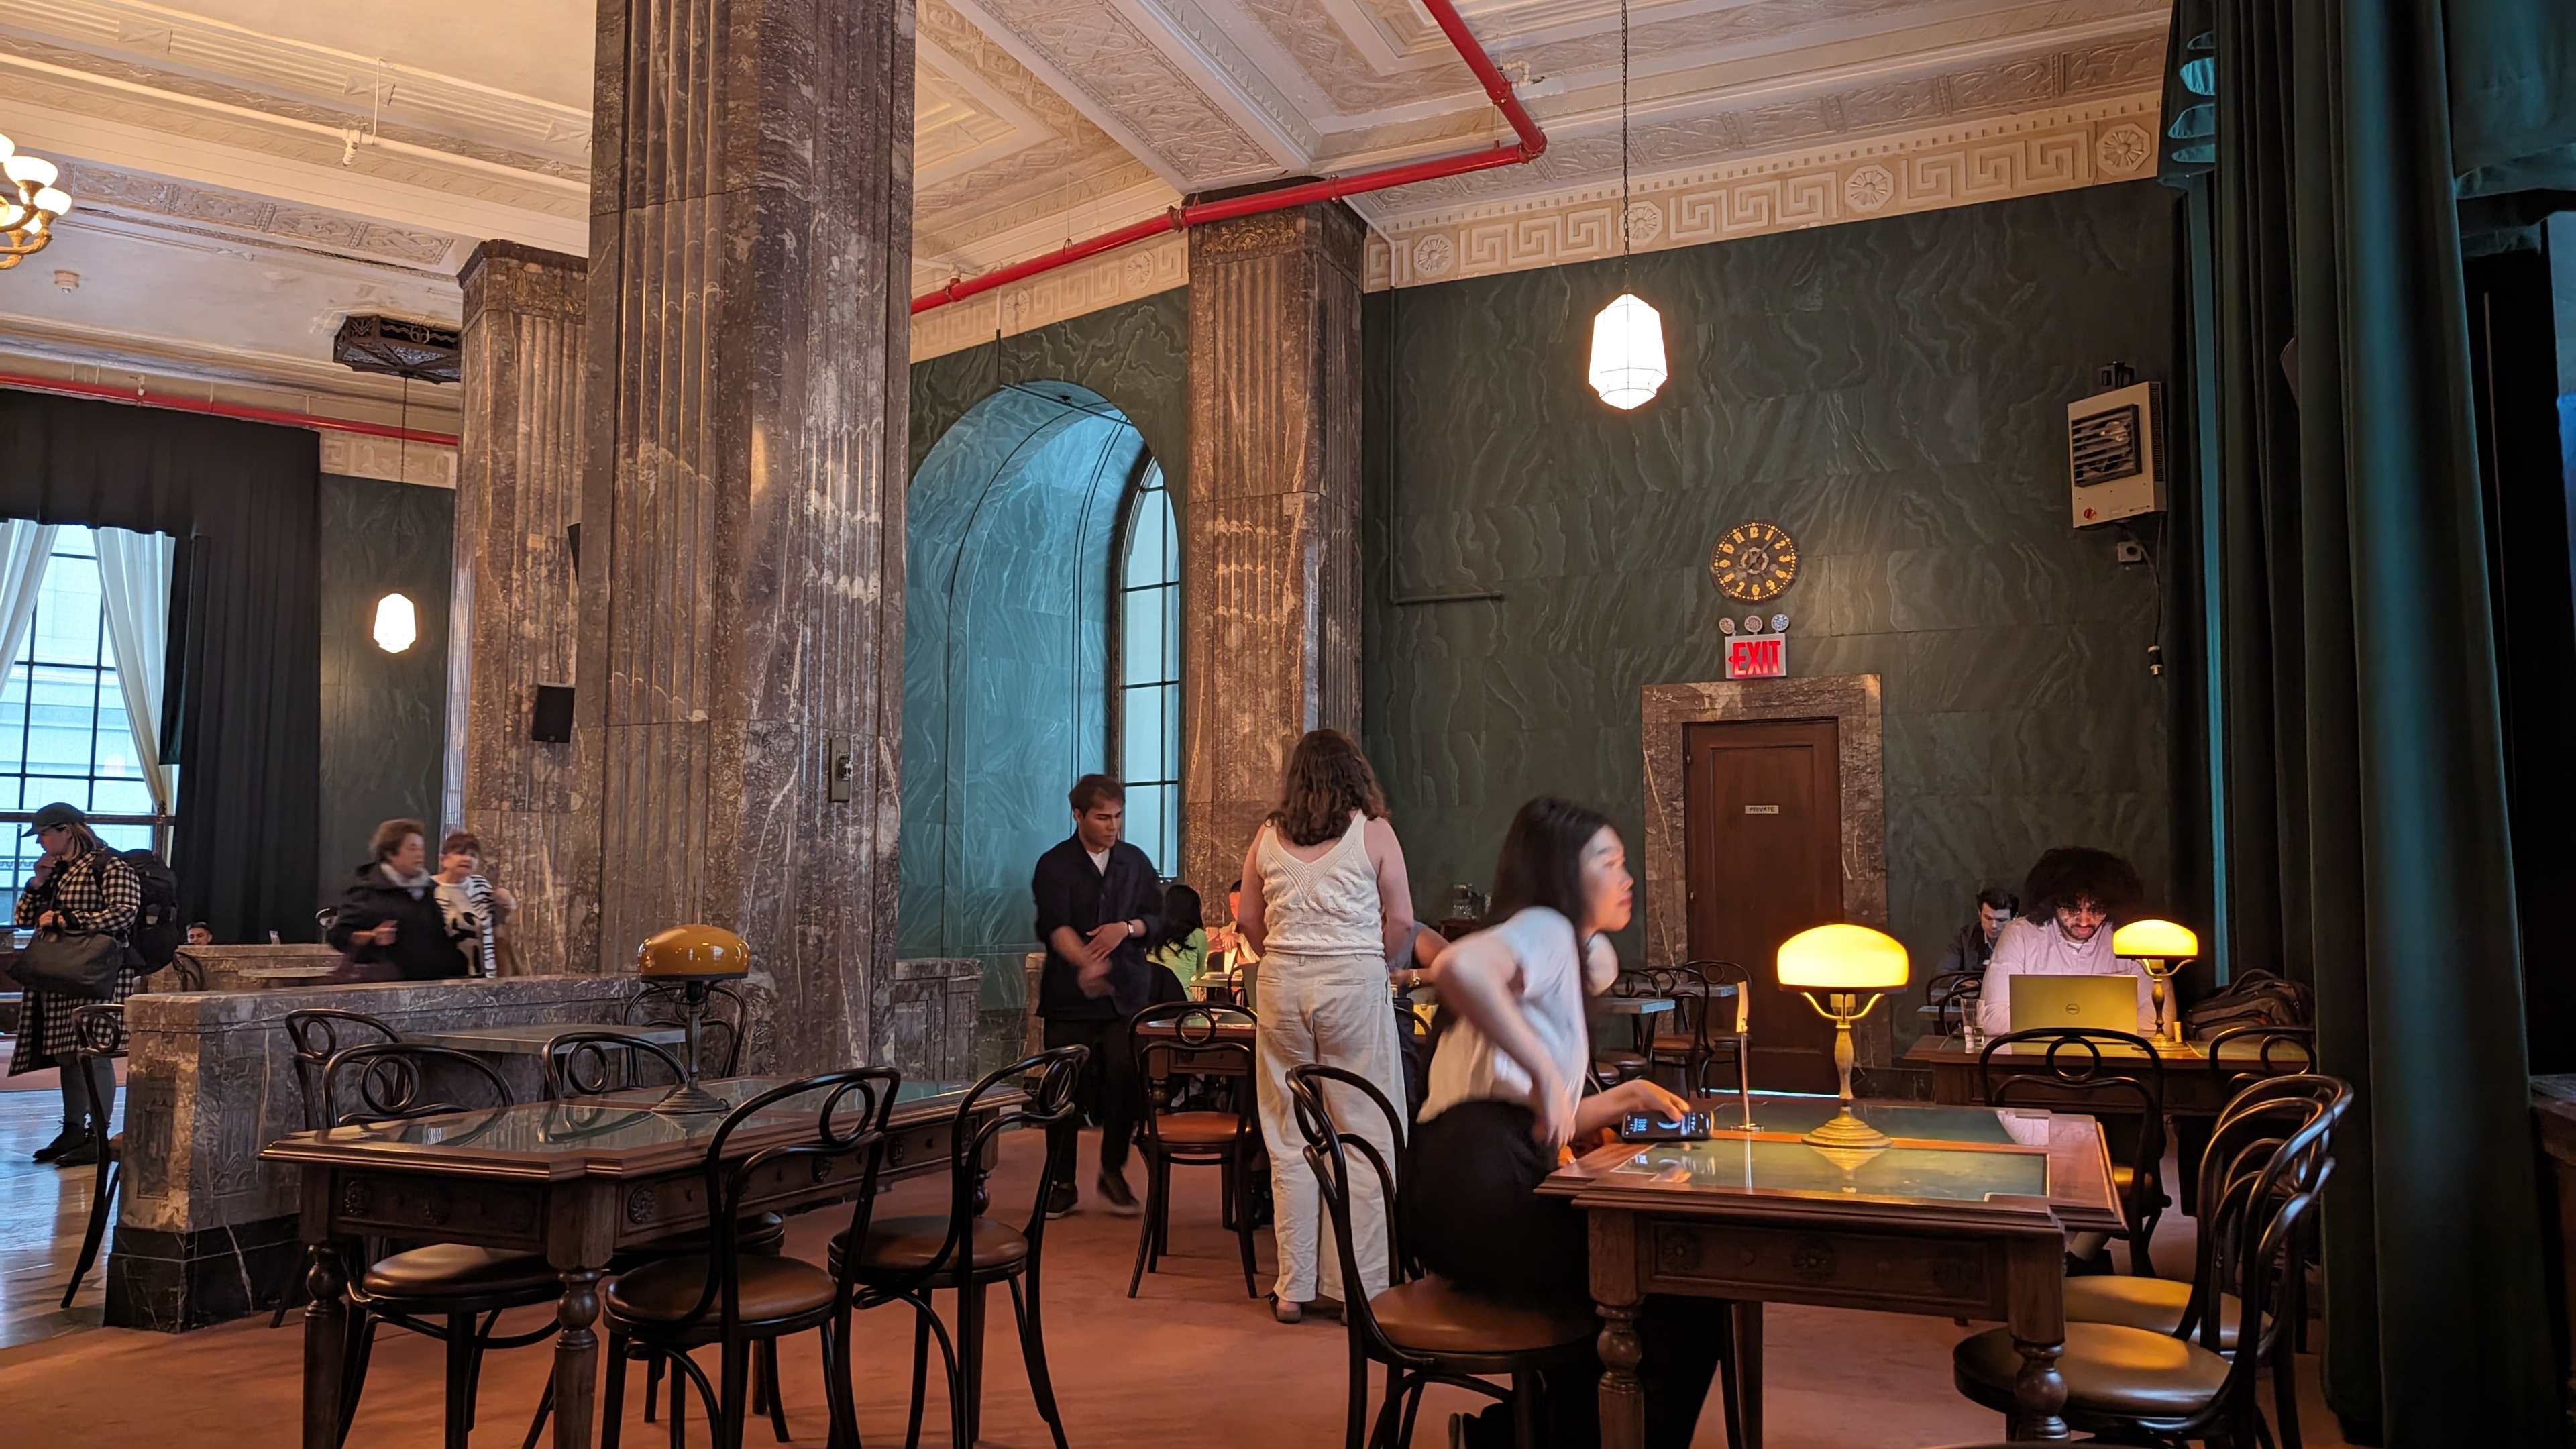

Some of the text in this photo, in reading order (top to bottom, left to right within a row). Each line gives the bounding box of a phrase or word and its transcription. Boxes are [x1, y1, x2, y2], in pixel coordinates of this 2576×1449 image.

[1764, 529, 1774, 541] 1
[1774, 540, 1786, 549] 2
[1719, 559, 1731, 568] 9
[1736, 581, 1745, 592] 7
[1751, 584, 1760, 596] 6
[1733, 640, 1781, 676] EXIT
